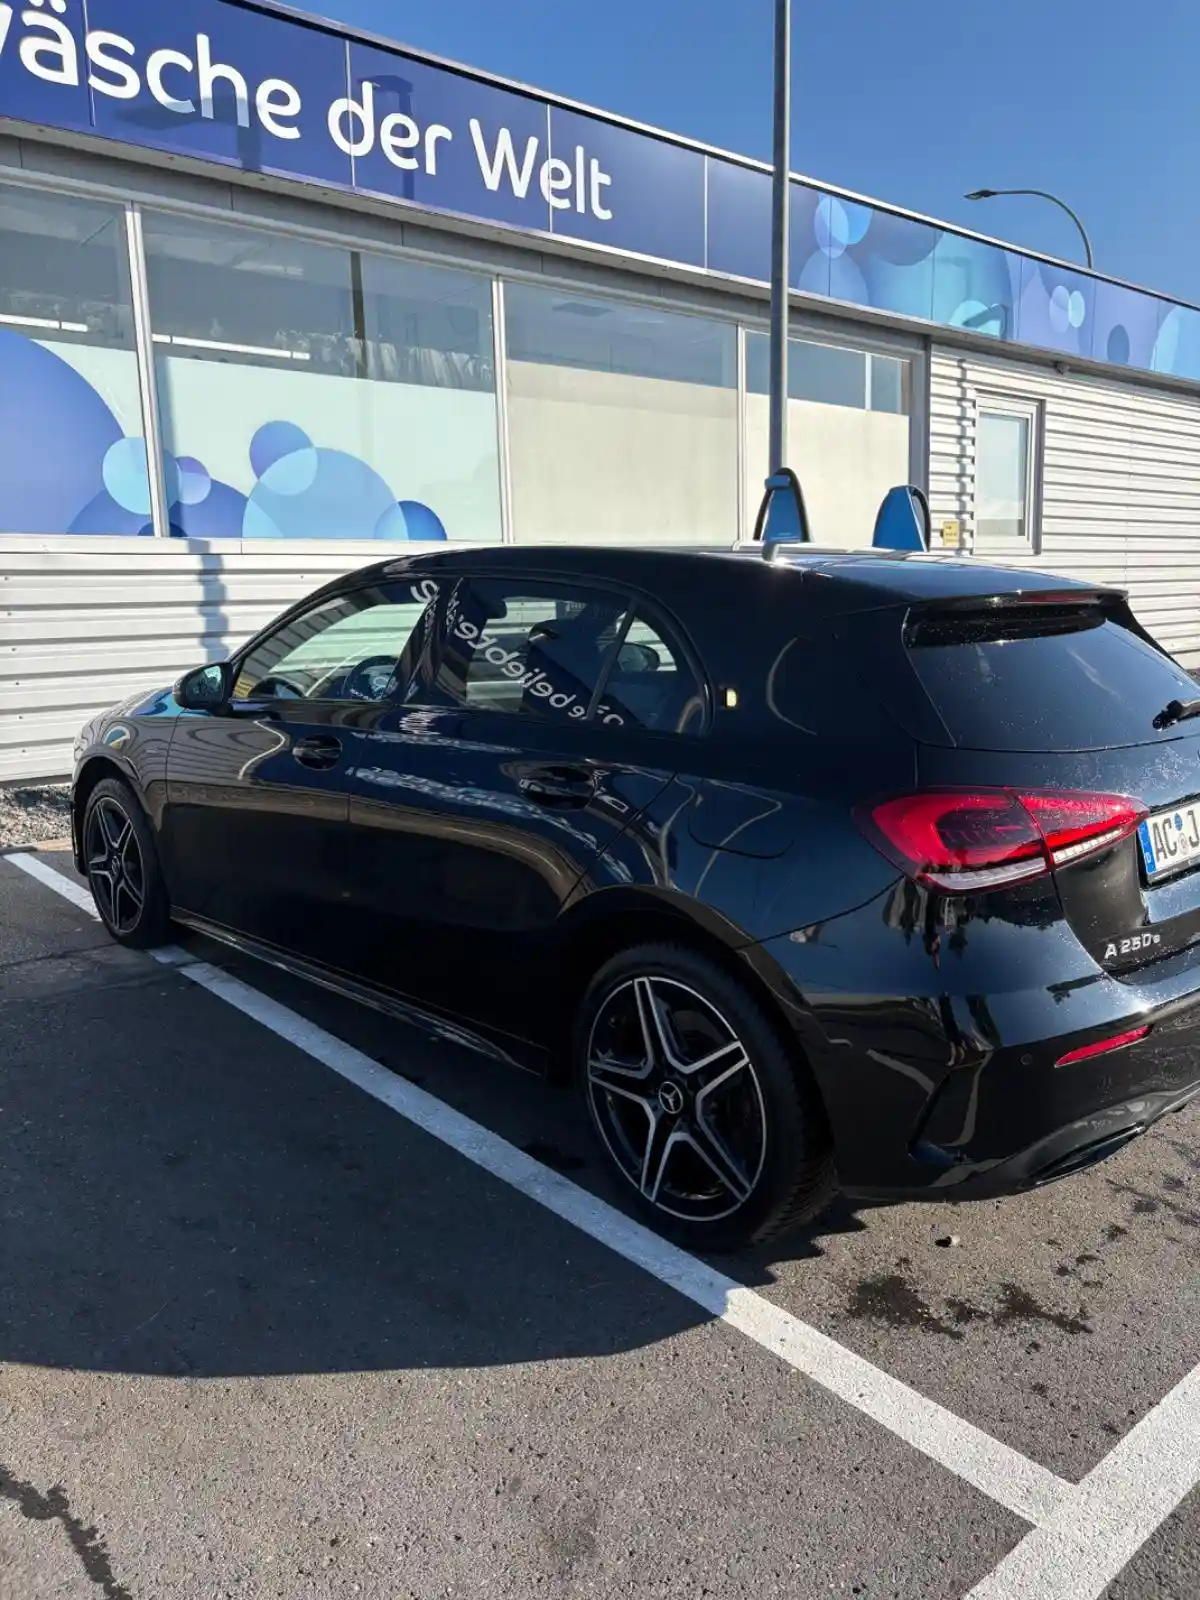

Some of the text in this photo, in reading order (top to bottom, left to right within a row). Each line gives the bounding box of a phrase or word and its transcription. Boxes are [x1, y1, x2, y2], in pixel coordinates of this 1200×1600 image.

[327, 81, 453, 176] der
[469, 118, 613, 220] Welt
[1152, 817, 1178, 863] AC
[1104, 943, 1118, 960] A
